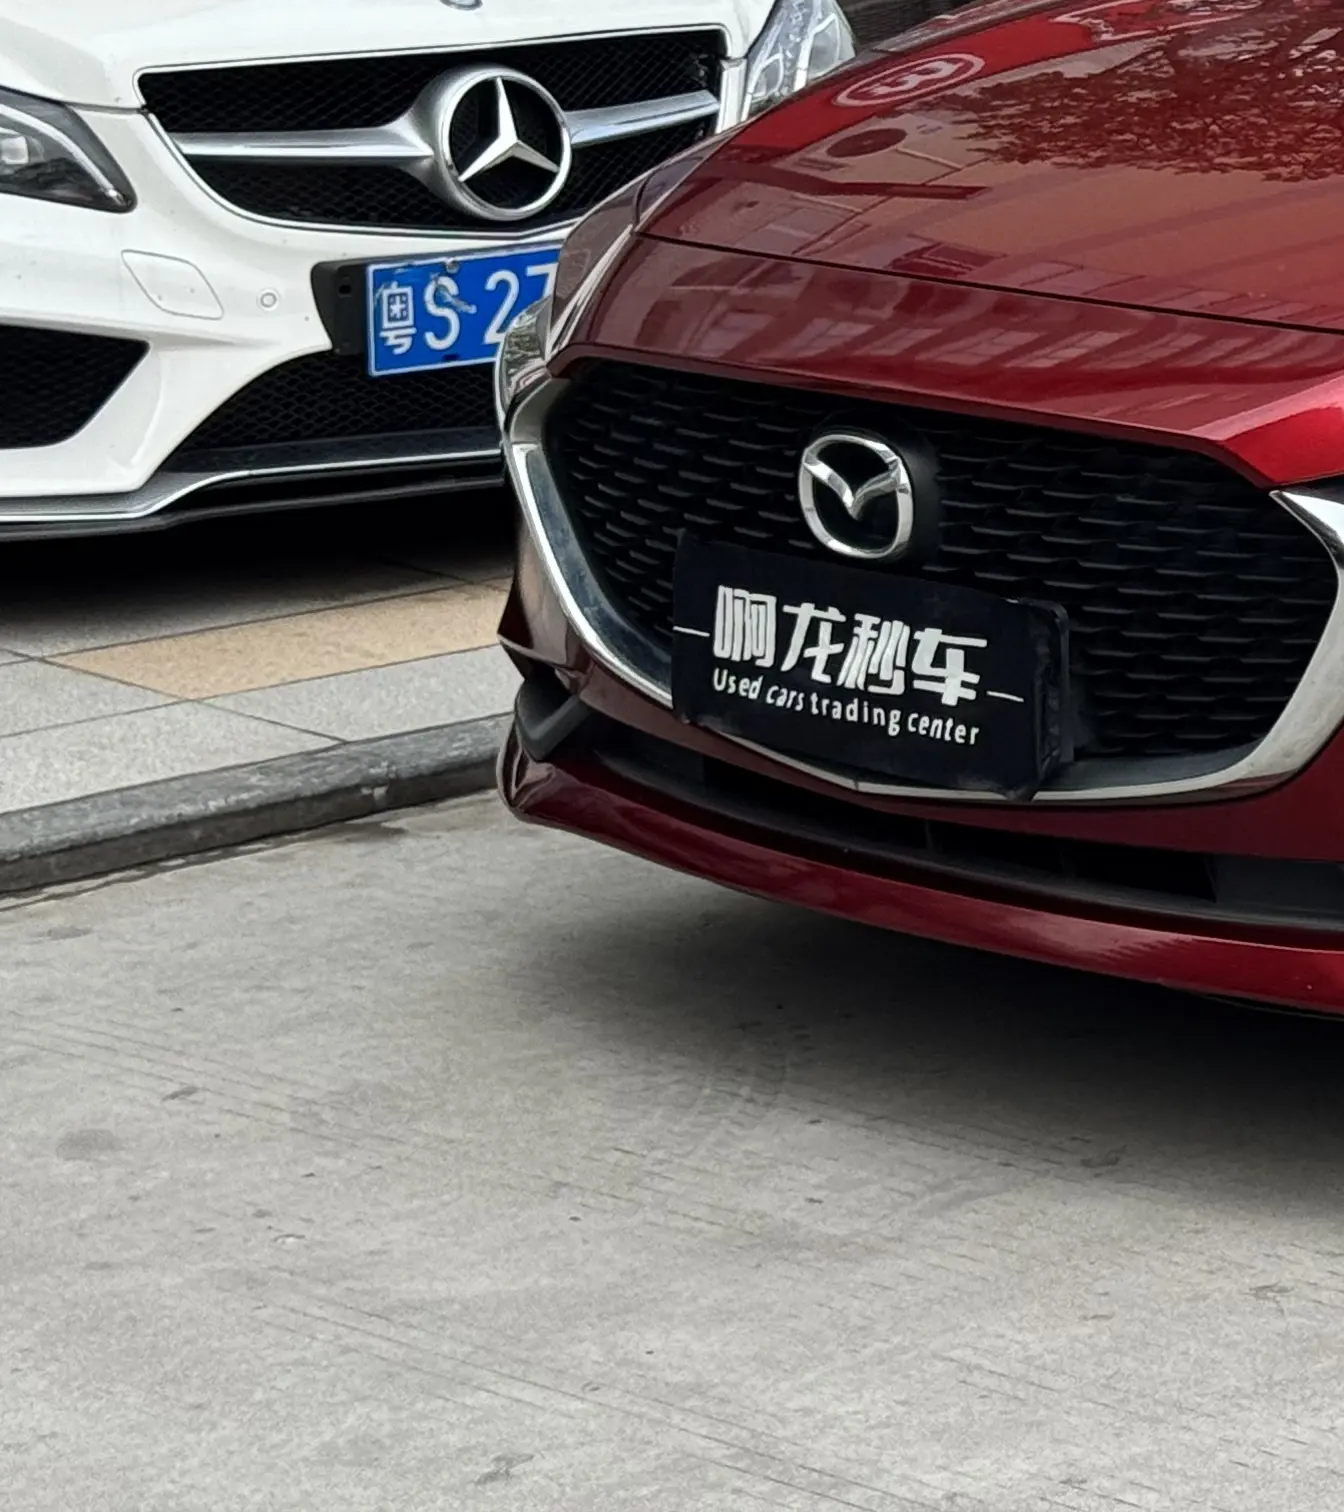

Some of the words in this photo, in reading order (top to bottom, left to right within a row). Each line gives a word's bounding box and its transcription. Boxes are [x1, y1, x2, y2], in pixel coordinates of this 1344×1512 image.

[713, 668, 763, 700] Used
[766, 685, 805, 711] cars
[809, 691, 901, 737] trading
[907, 711, 981, 746] center
